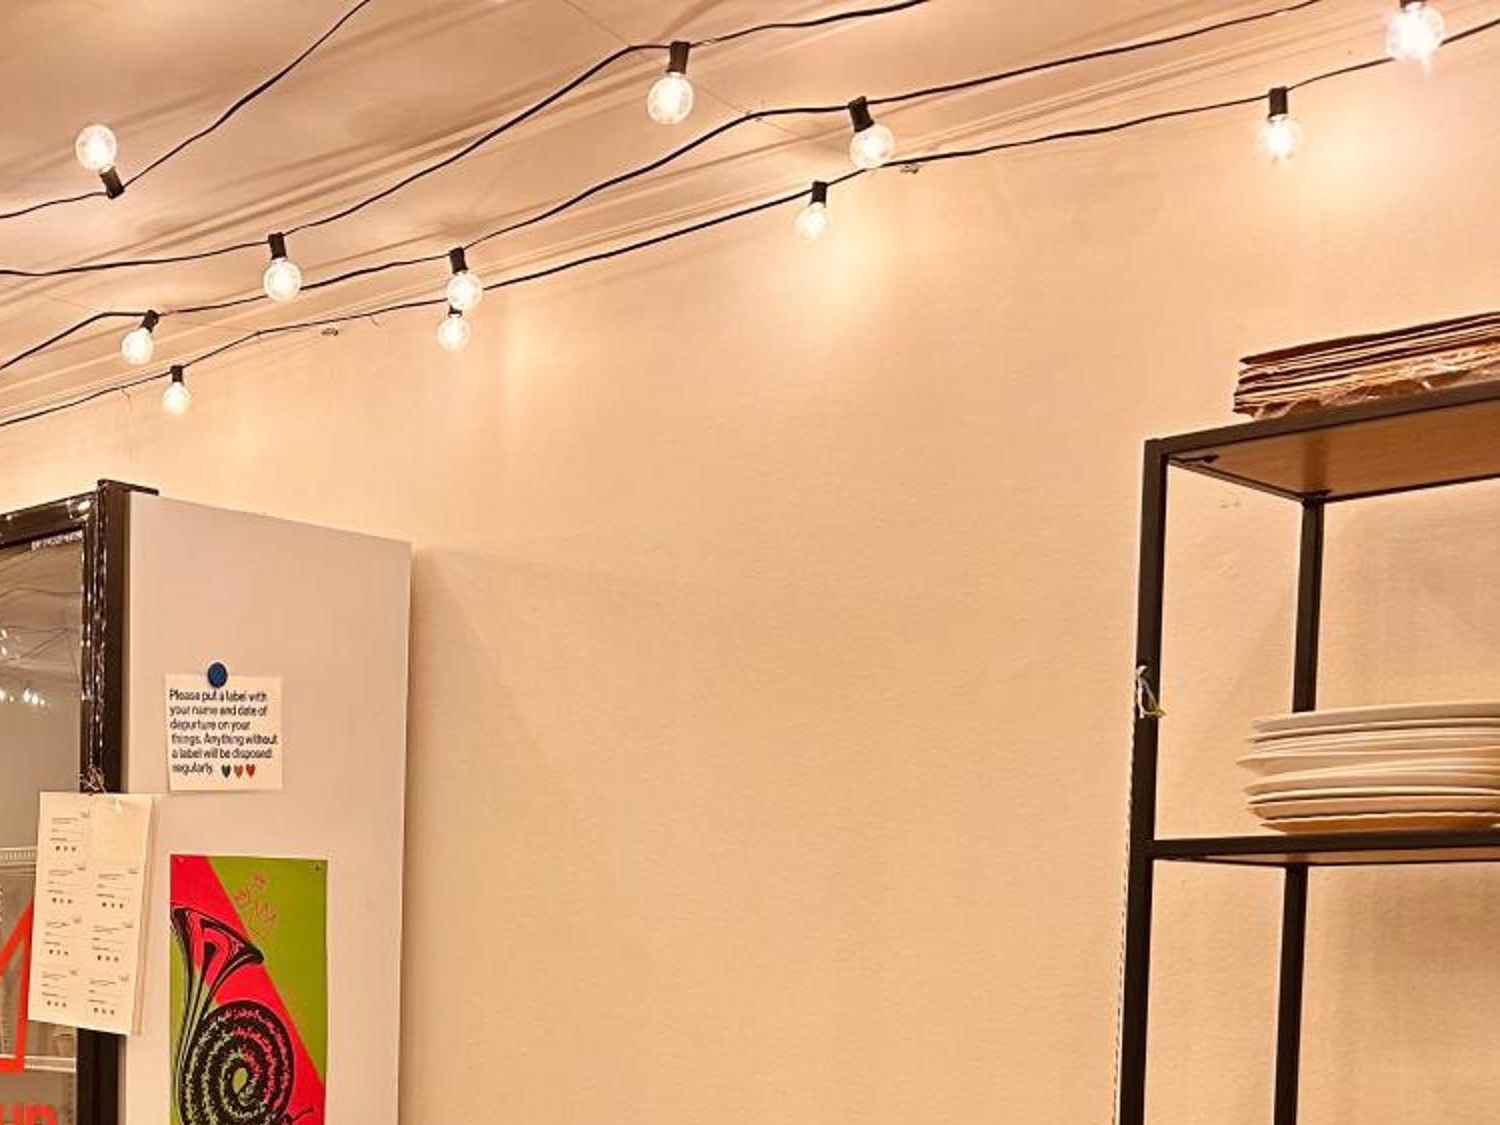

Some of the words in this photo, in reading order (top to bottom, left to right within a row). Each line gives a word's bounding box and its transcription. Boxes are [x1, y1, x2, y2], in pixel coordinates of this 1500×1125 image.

[169, 688, 200, 701] Please
[201, 690, 217, 702] put
[218, 693, 225, 702] a
[225, 690, 246, 702] label
[169, 705, 191, 716] your
[191, 705, 219, 715] name
[219, 704, 237, 716] and
[237, 705, 257, 716] date
[257, 705, 268, 716] of
[203, 732, 244, 746] Anything
[245, 734, 278, 745] without
[171, 749, 179, 759] a
[179, 748, 202, 759] label
[203, 747, 219, 759] will
[219, 749, 231, 759] be
